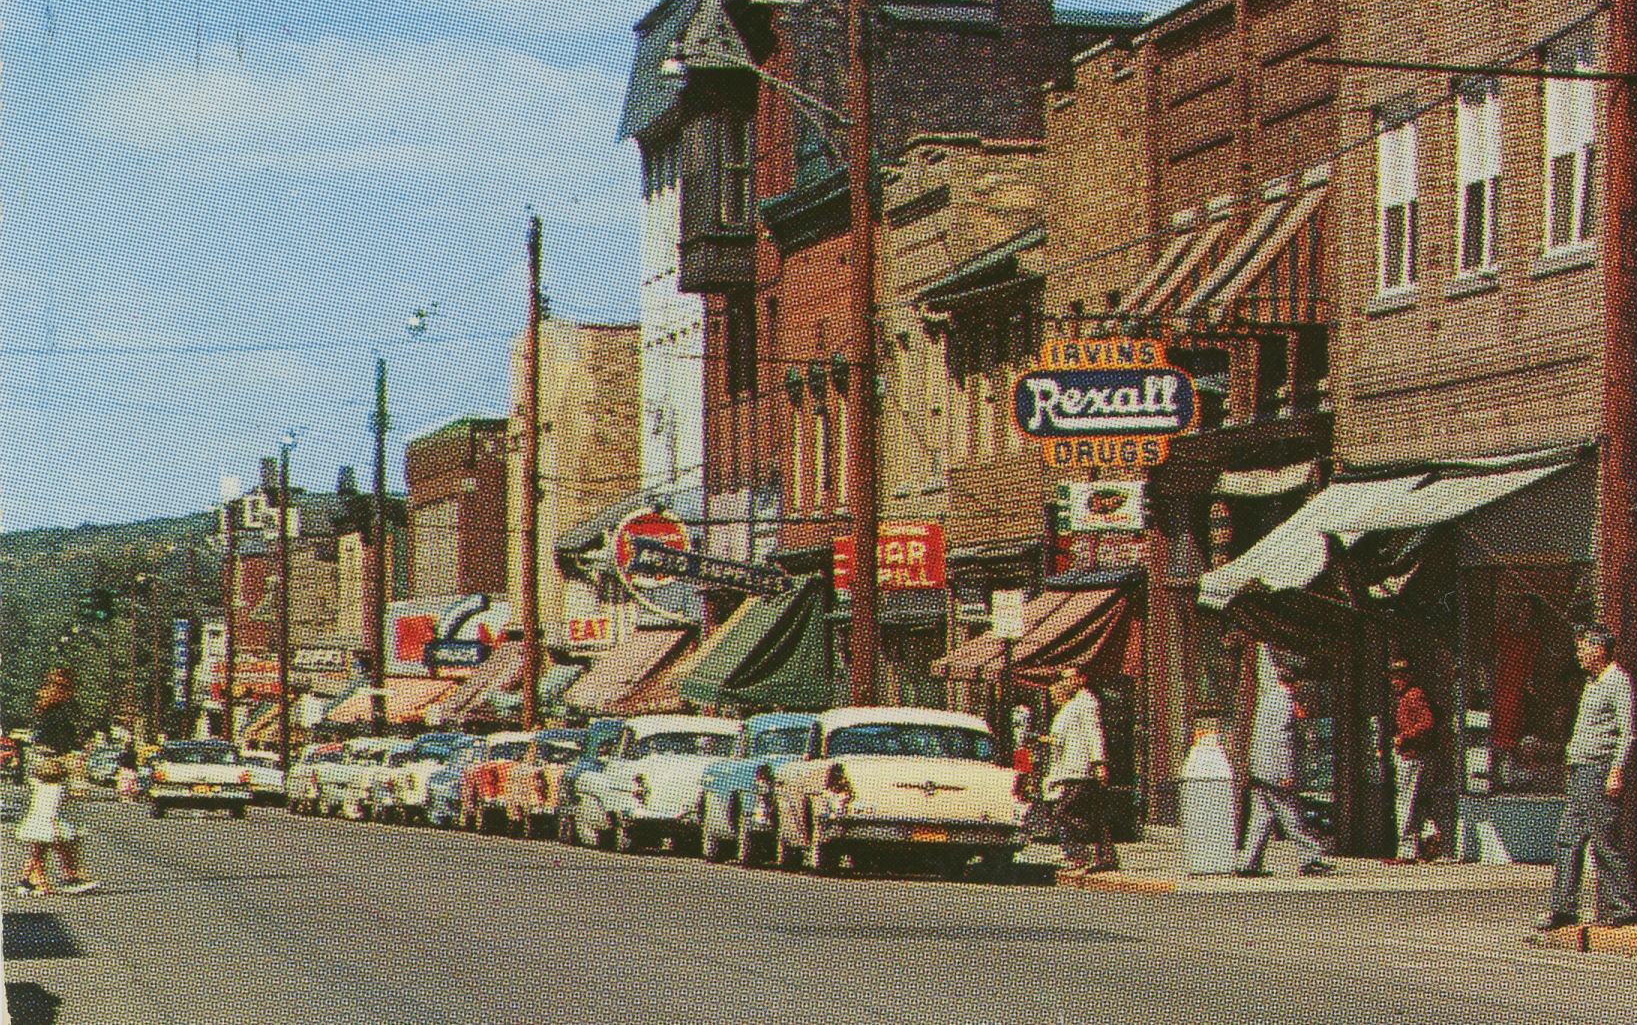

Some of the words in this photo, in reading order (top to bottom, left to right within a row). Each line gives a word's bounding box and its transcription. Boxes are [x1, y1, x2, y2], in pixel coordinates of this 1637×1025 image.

[1025, 375, 1180, 431] Rexall
[1054, 440, 1160, 465] DRUGS
[878, 539, 931, 565] AR
[568, 617, 611, 642] EAT
